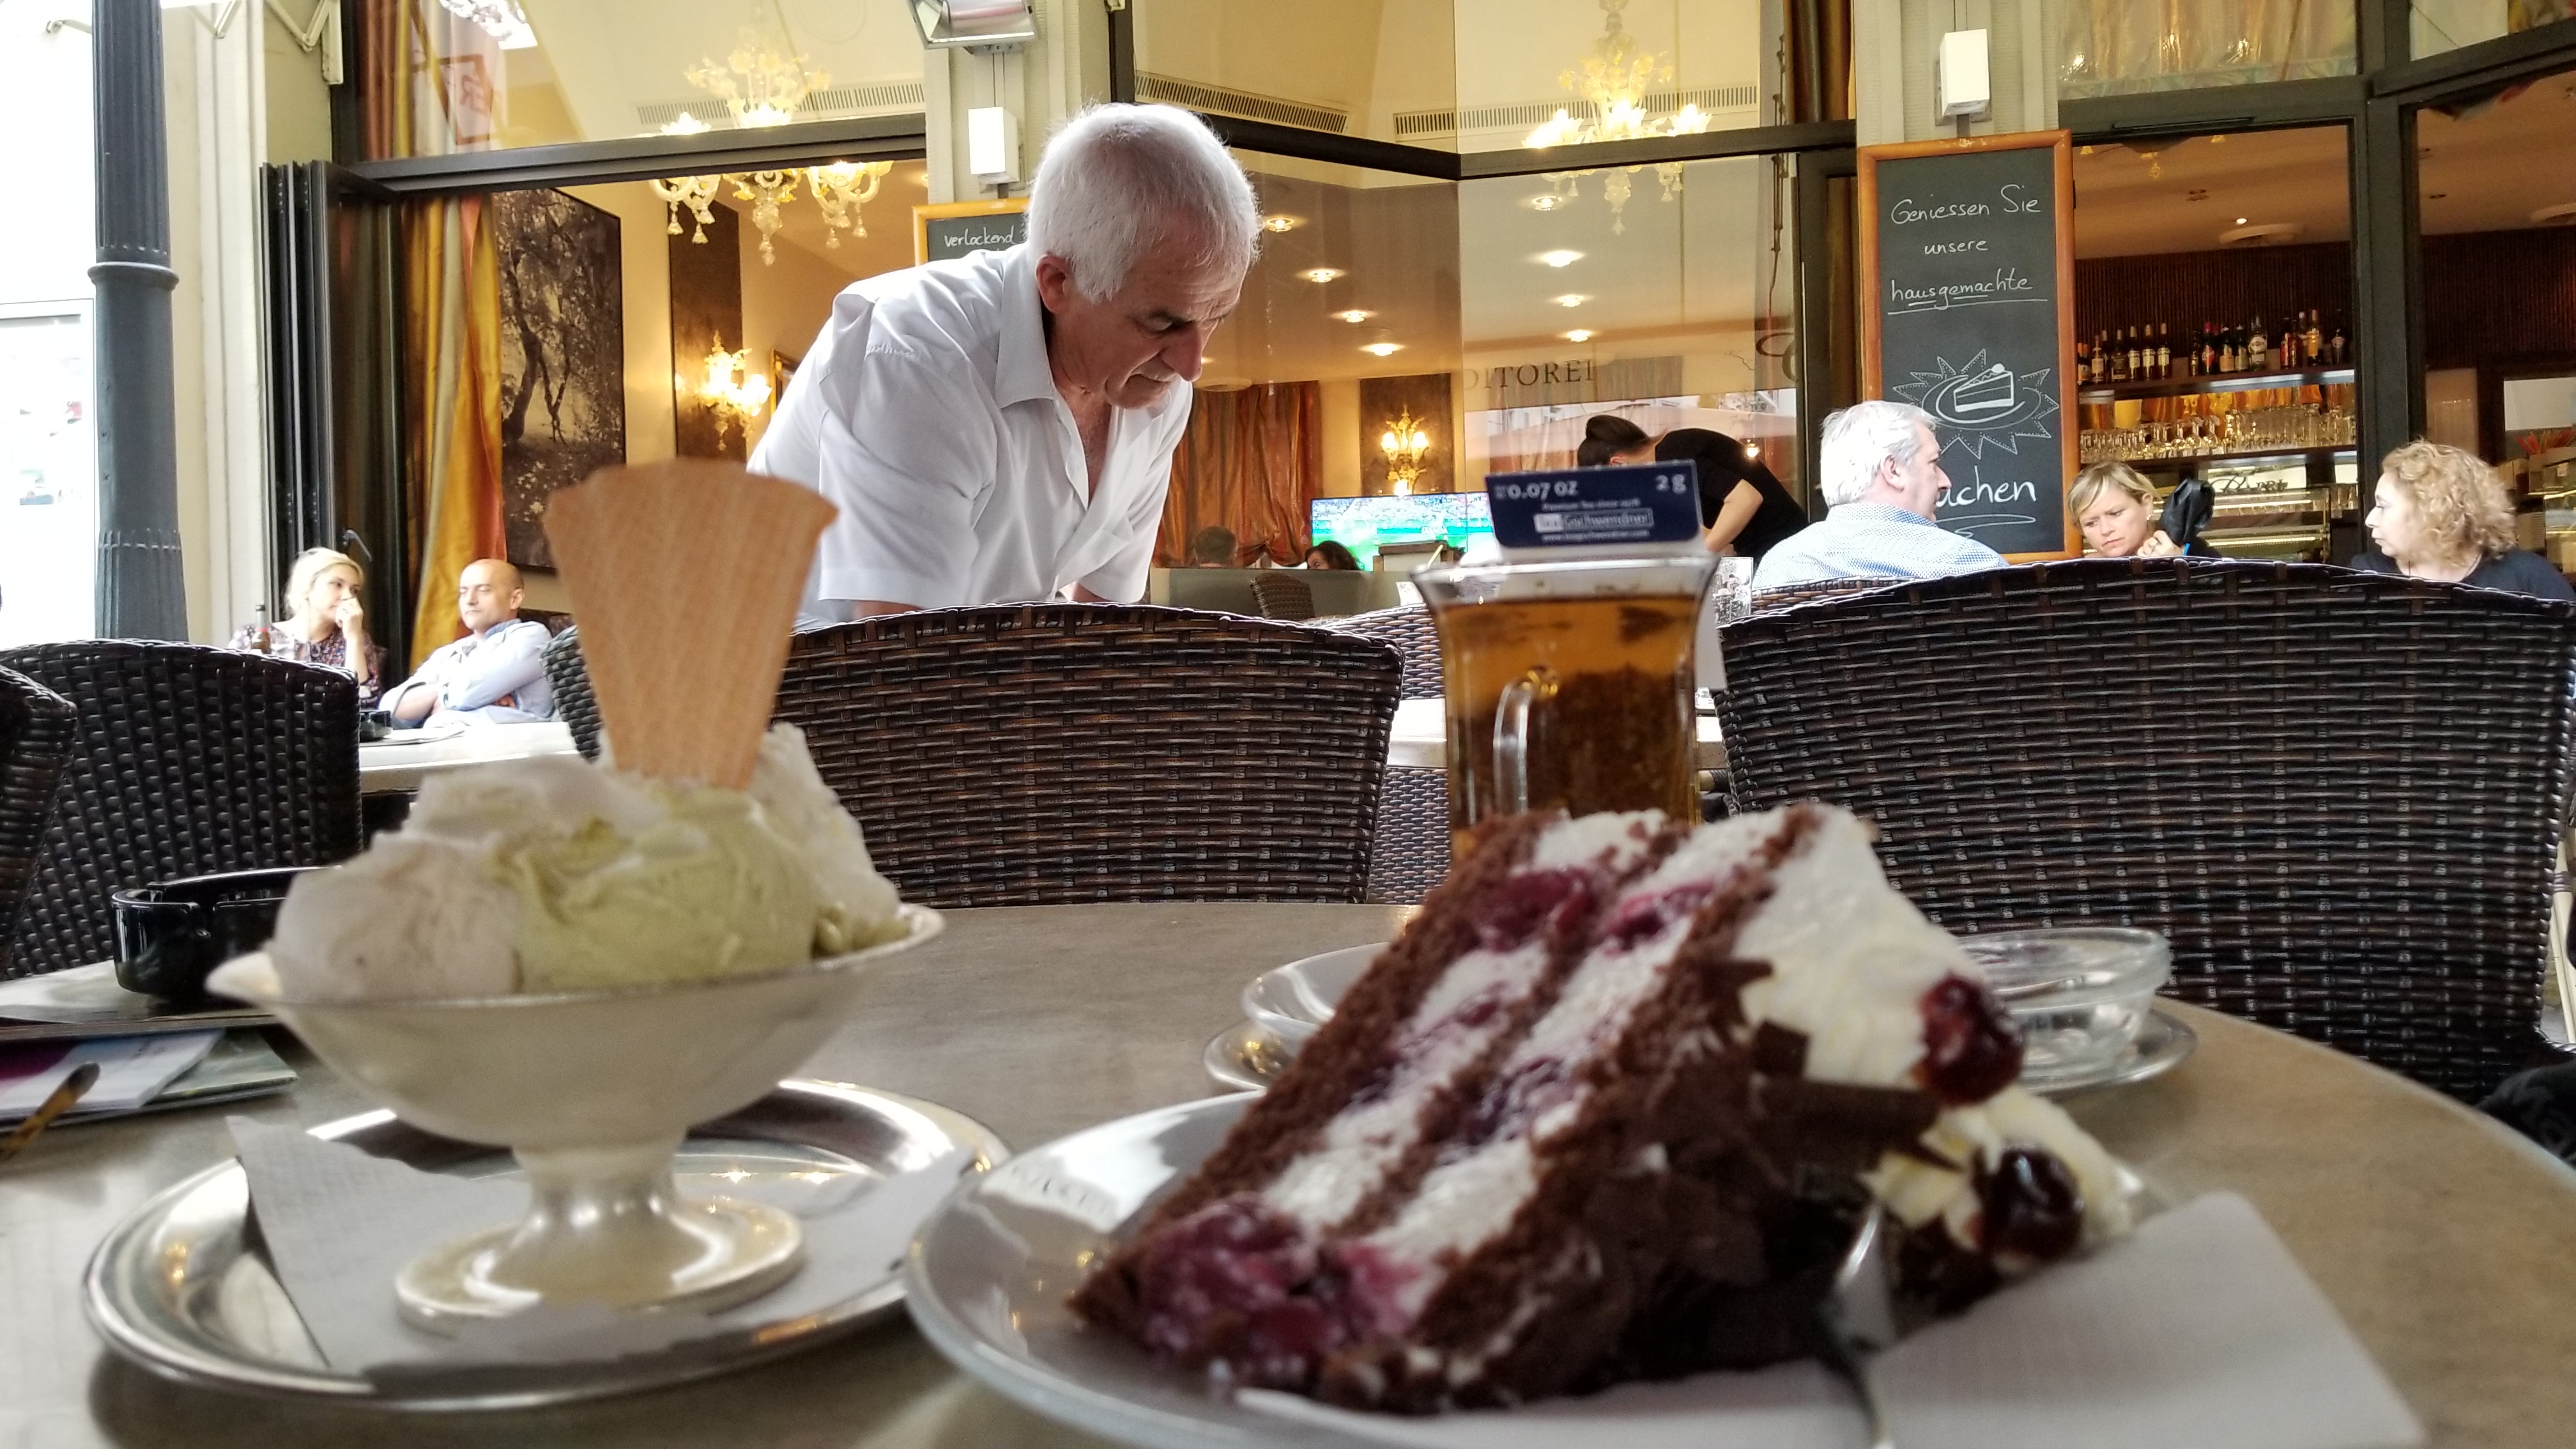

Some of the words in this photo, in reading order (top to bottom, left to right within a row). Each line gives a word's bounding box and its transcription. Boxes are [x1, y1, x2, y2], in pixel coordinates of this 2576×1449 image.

[1890, 198, 1990, 225] Geniessen
[2000, 183, 2041, 213] Sie
[1924, 239, 1989, 256] unsere
[1891, 267, 2034, 310] hausgemachte
[1936, 465, 2037, 507] uchen
